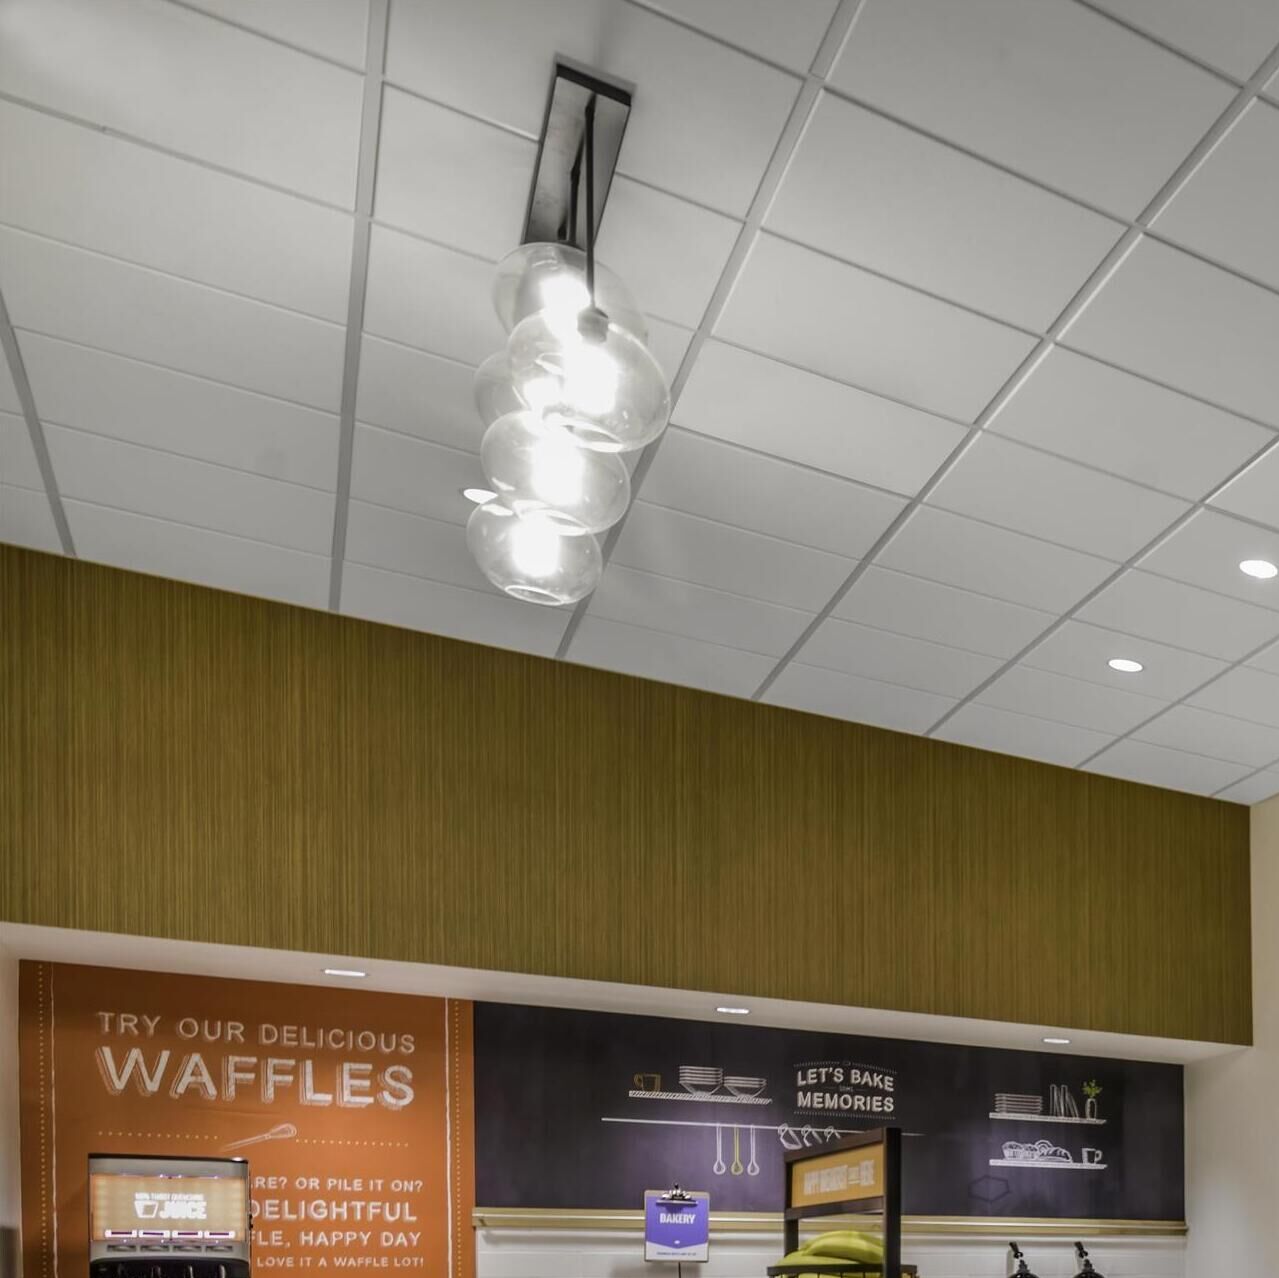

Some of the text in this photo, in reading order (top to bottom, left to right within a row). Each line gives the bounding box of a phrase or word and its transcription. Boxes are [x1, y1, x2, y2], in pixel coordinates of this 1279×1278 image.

[98, 1011, 415, 1053] TRY OUR DELICIOUS
[96, 1046, 415, 1110] WAFFLES
[797, 1067, 894, 1092] LET'S BAKE
[797, 1091, 895, 1112] MEMORIES
[296, 1177, 320, 1190] OR
[327, 1178, 363, 1192] PILE
[369, 1179, 384, 1193] IT
[391, 1179, 423, 1193] ON?
[159, 1201, 207, 1219] JUICE
[660, 1213, 696, 1224] BAKERY
[301, 1231, 371, 1247] HAPPY
[381, 1231, 421, 1247] DAY
[257, 1256, 424, 1268] LOVE IT A WAFFLE LOT!
